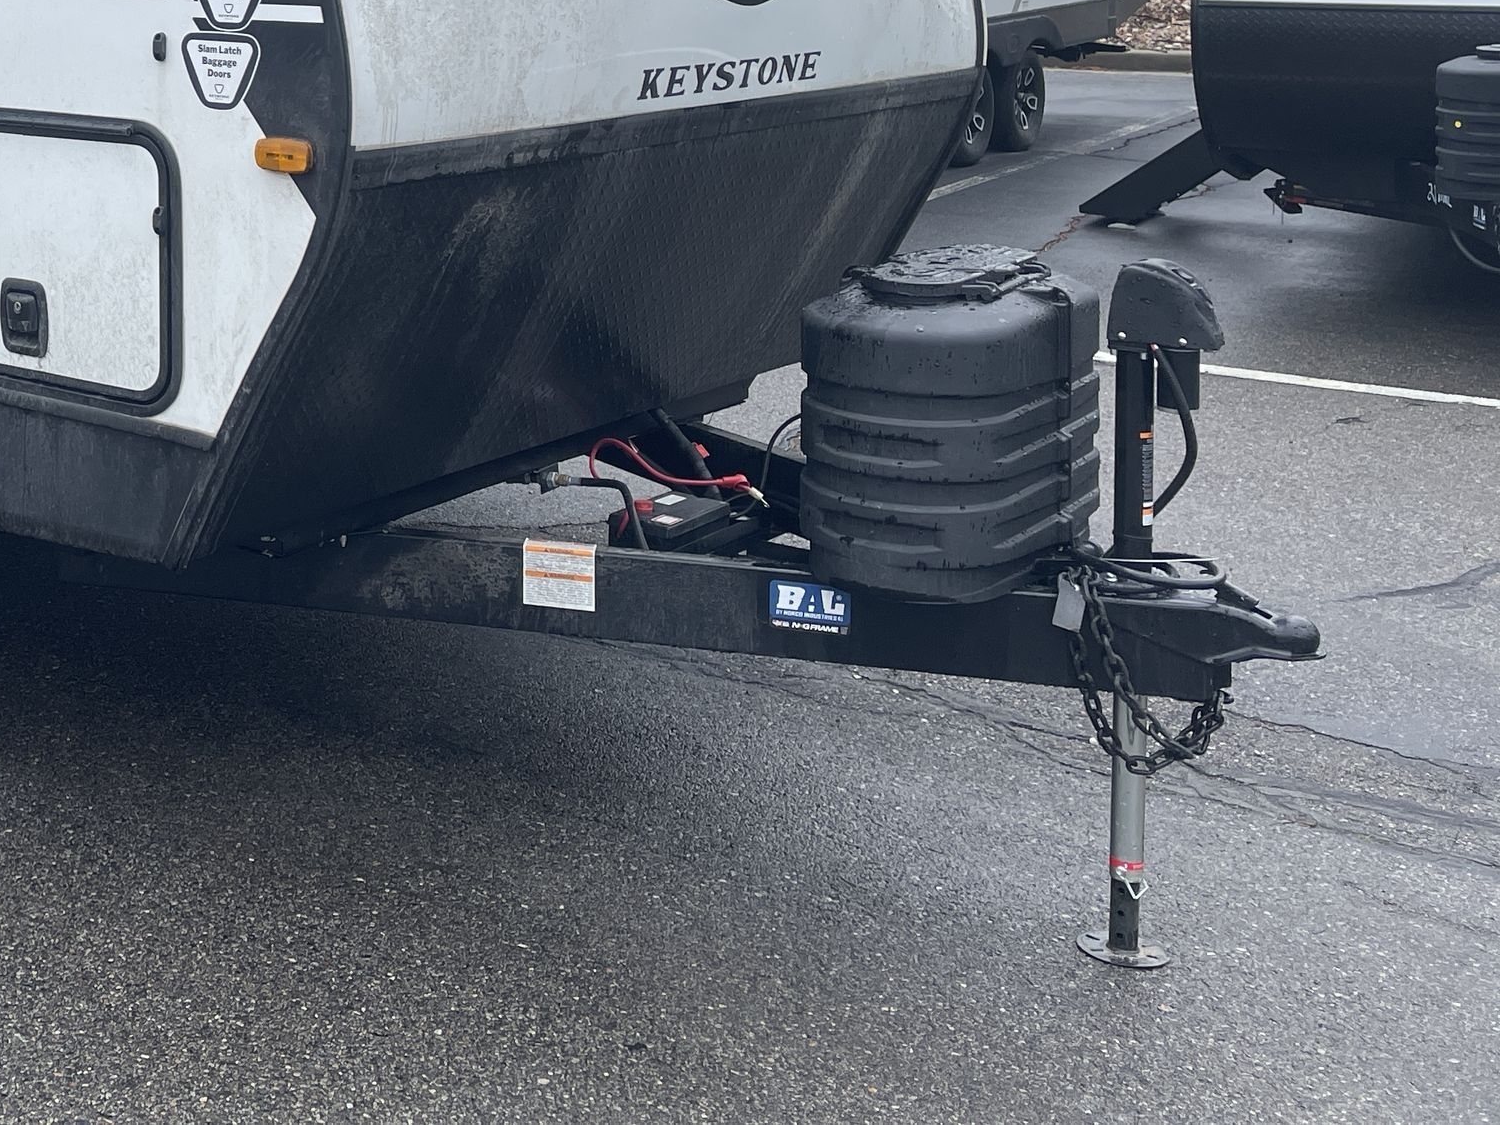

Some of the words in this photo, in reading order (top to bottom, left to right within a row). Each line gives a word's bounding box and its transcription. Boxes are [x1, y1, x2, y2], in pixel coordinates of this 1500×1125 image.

[197, 44, 218, 53] Slam
[219, 45, 242, 55] Latch
[202, 56, 237, 68] Baggage
[207, 68, 231, 78] Doors
[636, 50, 822, 101] KEYSTONE
[776, 584, 845, 616] BAL
